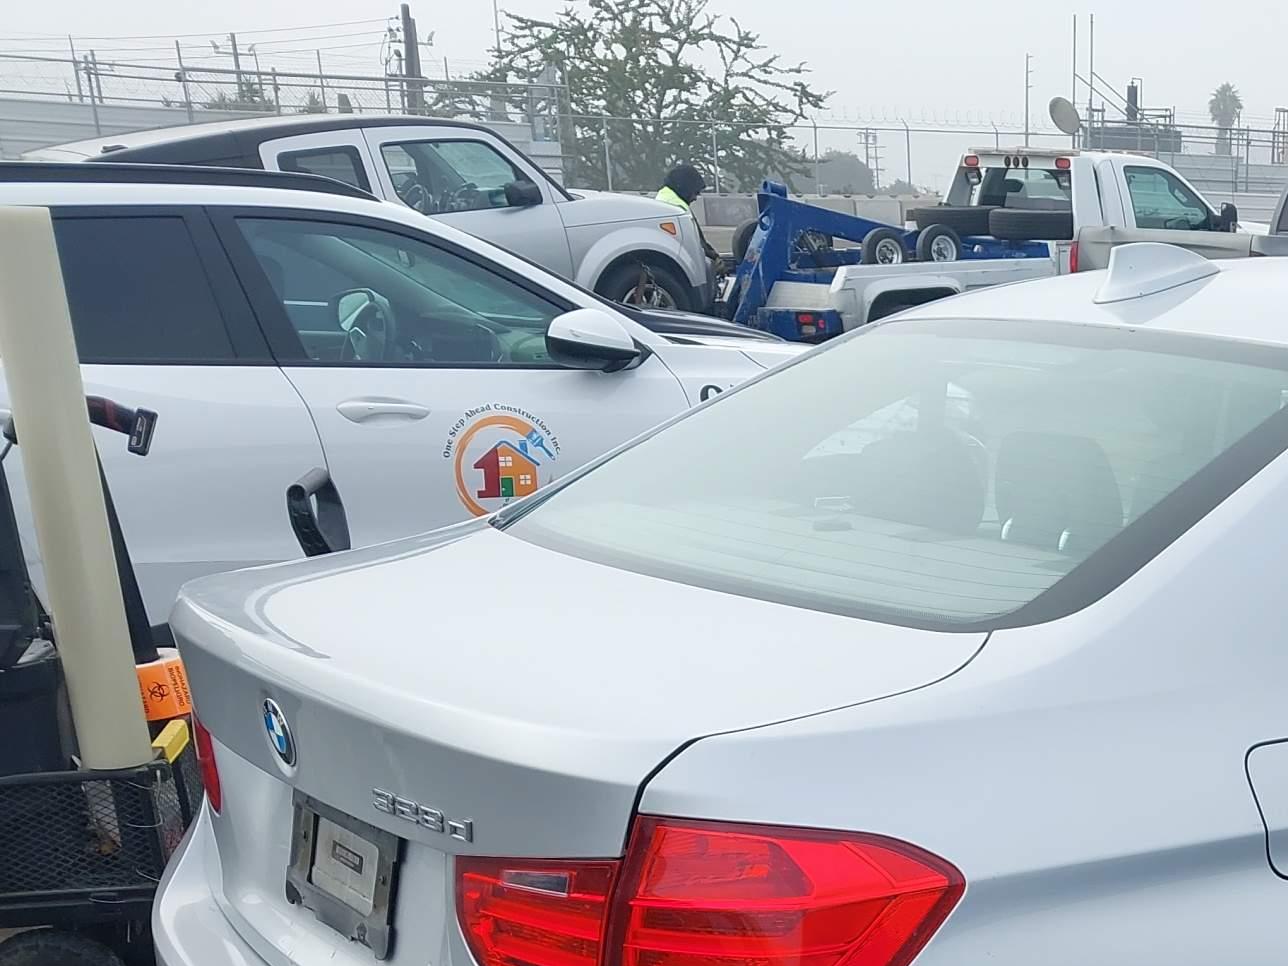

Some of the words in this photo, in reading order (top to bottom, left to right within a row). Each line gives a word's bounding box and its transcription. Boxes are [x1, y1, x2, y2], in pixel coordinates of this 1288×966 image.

[443, 437, 453, 458] One
[449, 418, 465, 438] Step
[464, 403, 492, 420] Ahead
[493, 403, 552, 436] Construction
